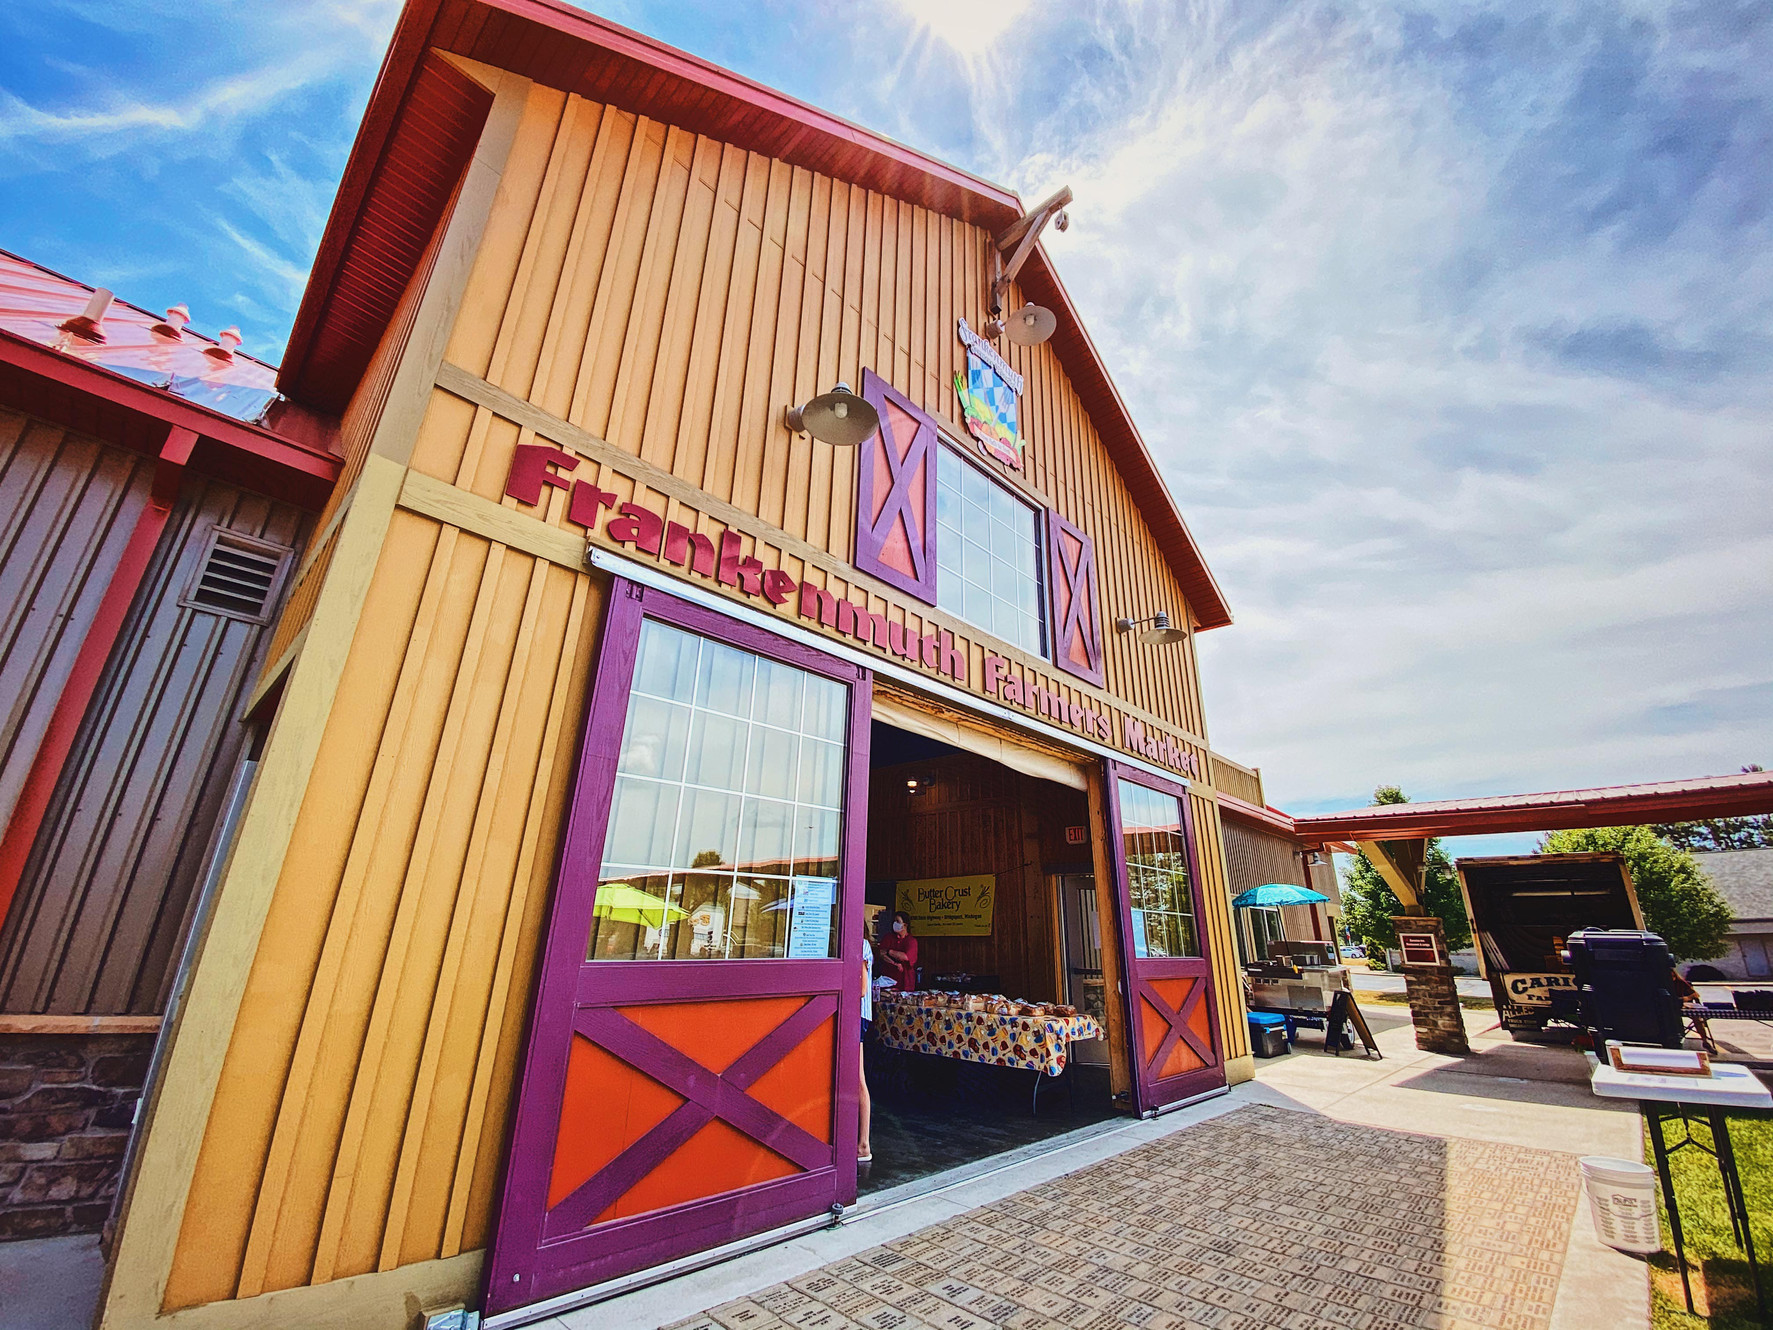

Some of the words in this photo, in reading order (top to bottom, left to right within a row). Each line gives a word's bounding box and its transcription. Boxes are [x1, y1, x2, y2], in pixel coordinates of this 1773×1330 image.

[505, 444, 966, 681] Frankenmuth
[985, 656, 1113, 740] Farmers
[1124, 715, 1199, 780] Market
[1068, 828, 1084, 841] EXIT
[917, 887, 944, 902] Butter
[944, 885, 972, 901] Crust
[929, 898, 961, 913] Bakery
[1510, 976, 1577, 995] CARI
